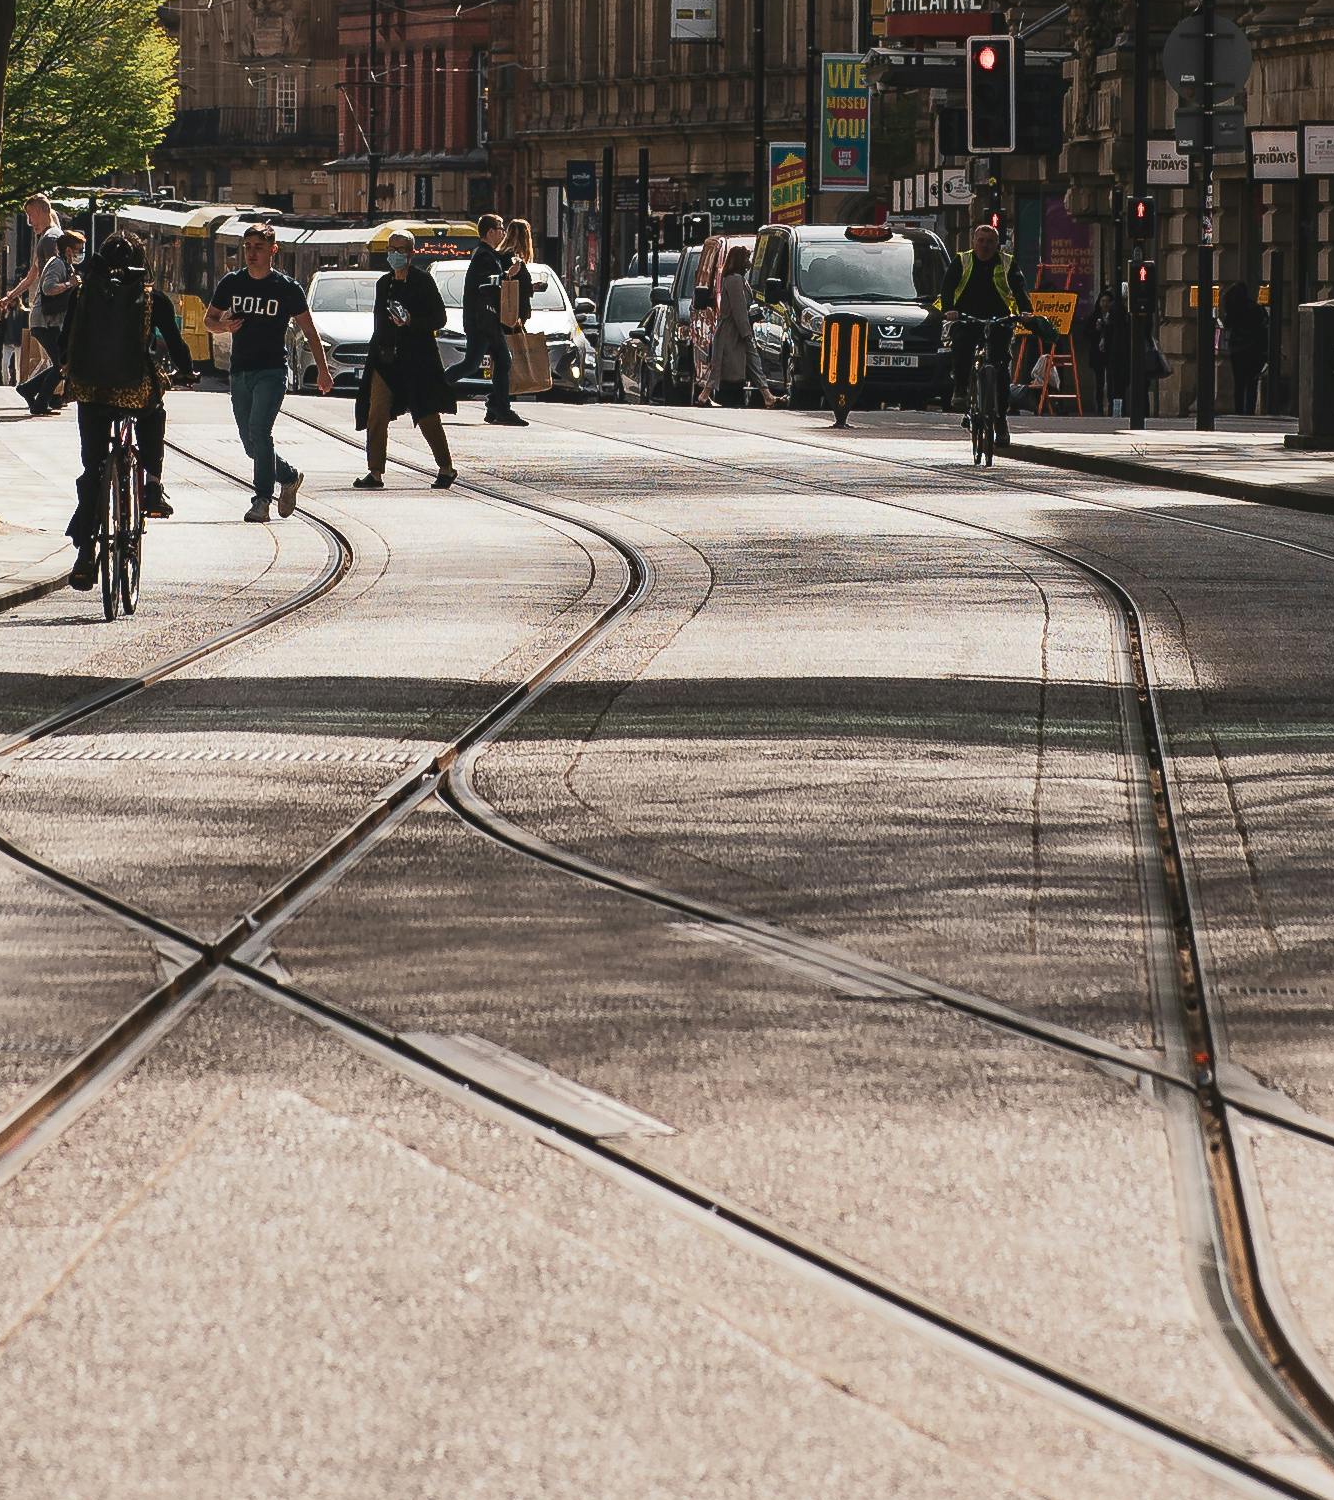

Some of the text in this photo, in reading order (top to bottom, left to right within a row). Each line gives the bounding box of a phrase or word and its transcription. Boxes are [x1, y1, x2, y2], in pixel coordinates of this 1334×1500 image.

[827, 62, 867, 89] WE
[826, 96, 867, 110] MISSED
[826, 118, 866, 139] YOU!
[708, 197, 752, 207] TO LET
[232, 295, 279, 316] POLO
[1035, 300, 1071, 314] Diverted
[892, 355, 912, 367] NPU
